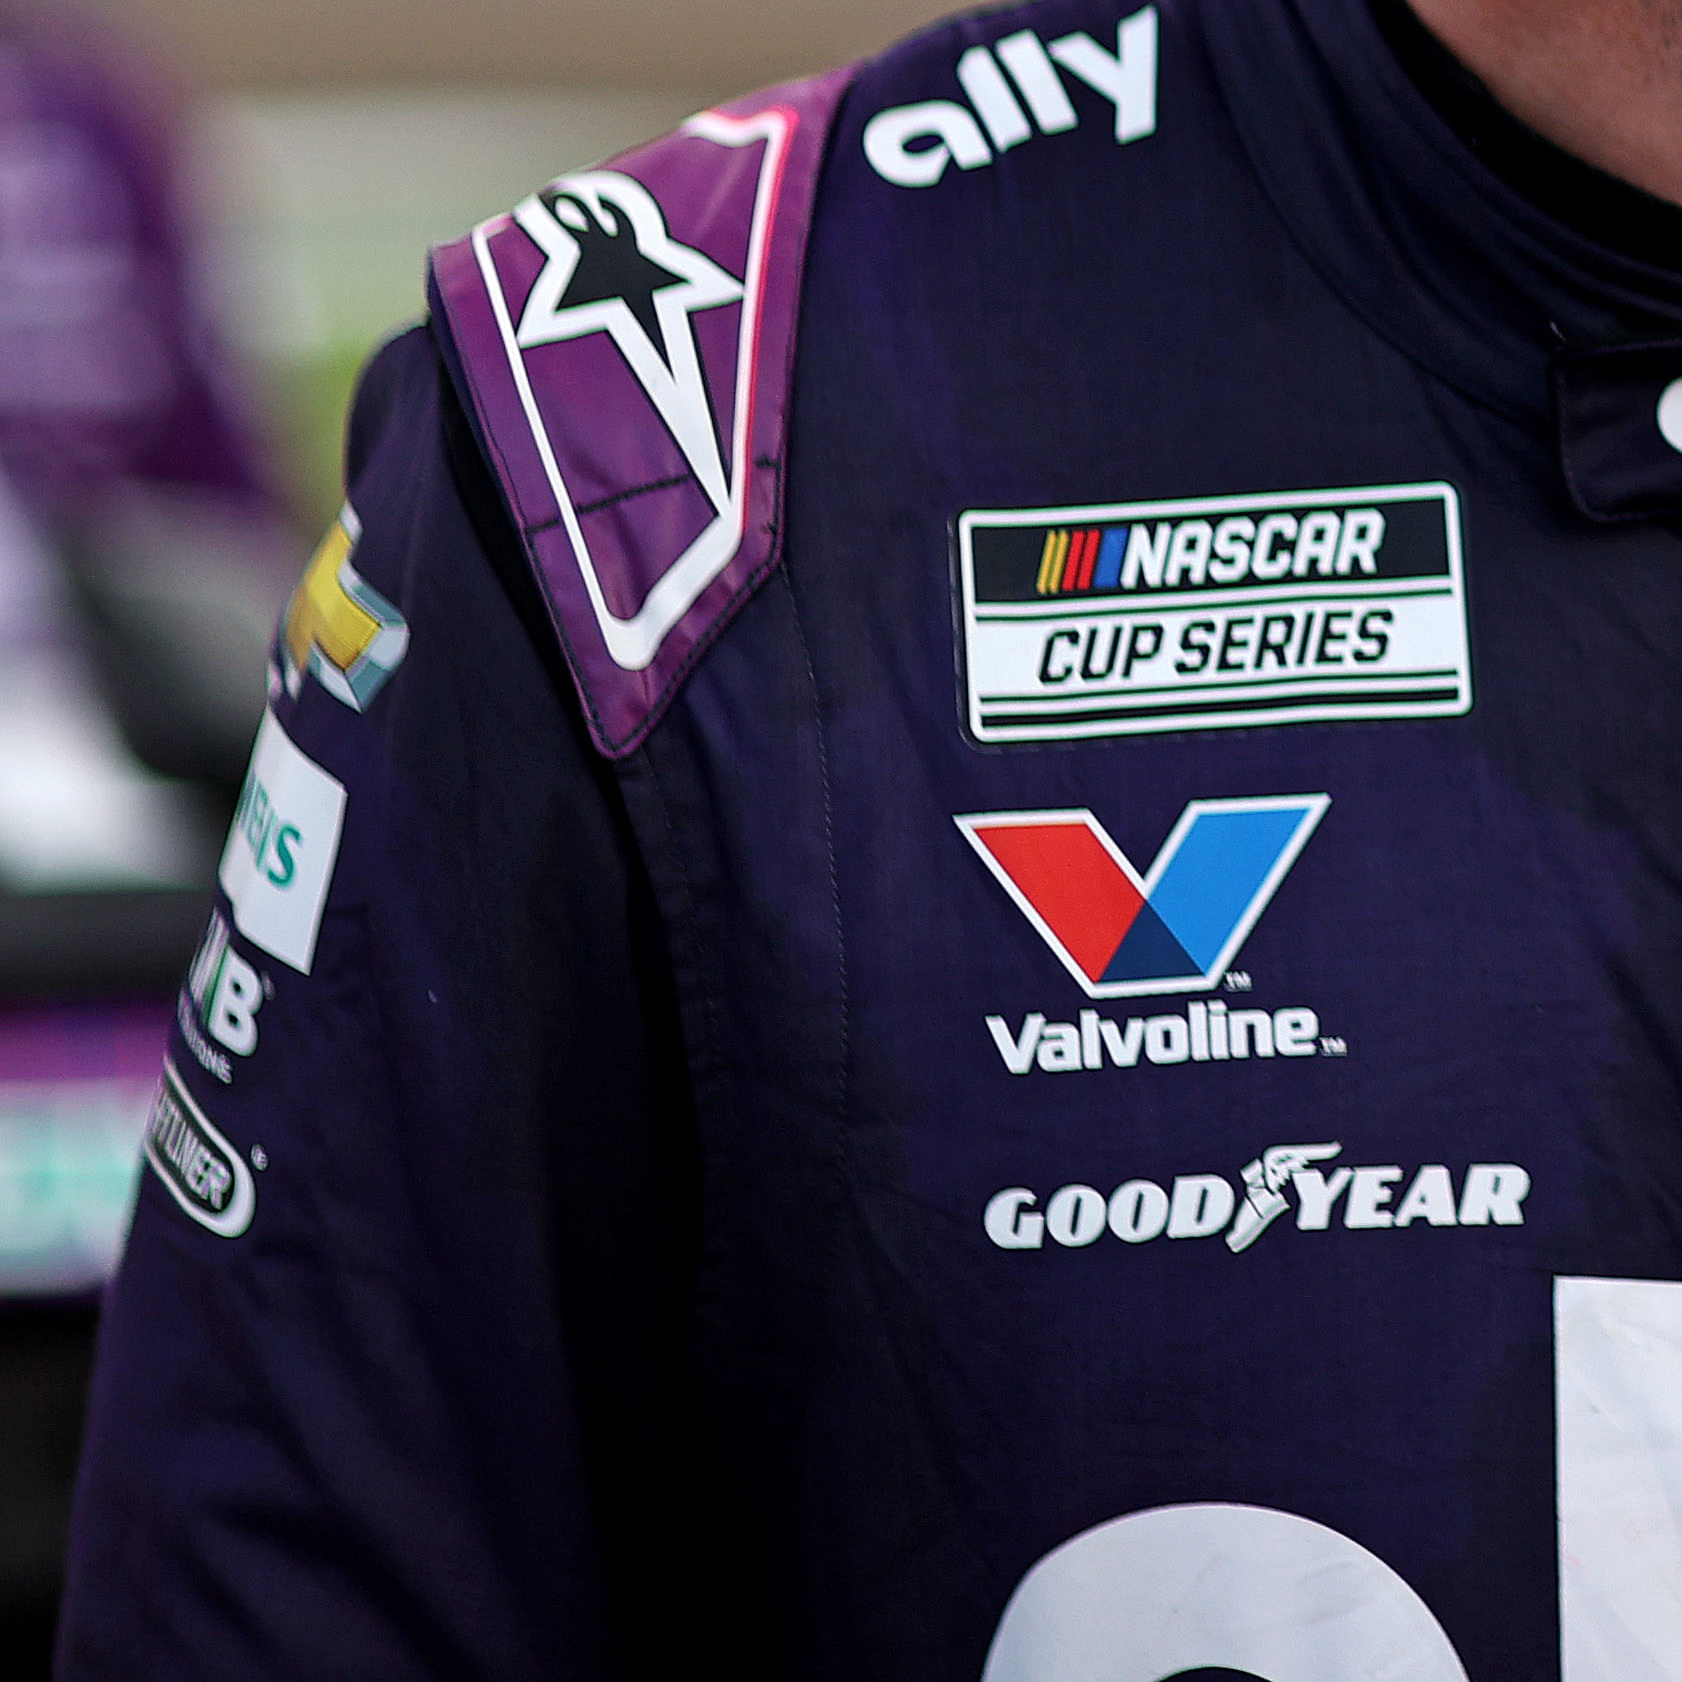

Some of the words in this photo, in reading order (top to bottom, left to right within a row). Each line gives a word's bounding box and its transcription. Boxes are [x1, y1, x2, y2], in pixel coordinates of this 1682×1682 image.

[864, 6, 1158, 186] ally
[1120, 506, 1386, 590] NASCAR
[1038, 623, 1165, 685] CUP
[1173, 610, 1395, 675] SERIES
[985, 1000, 1320, 1074] Valvoline
